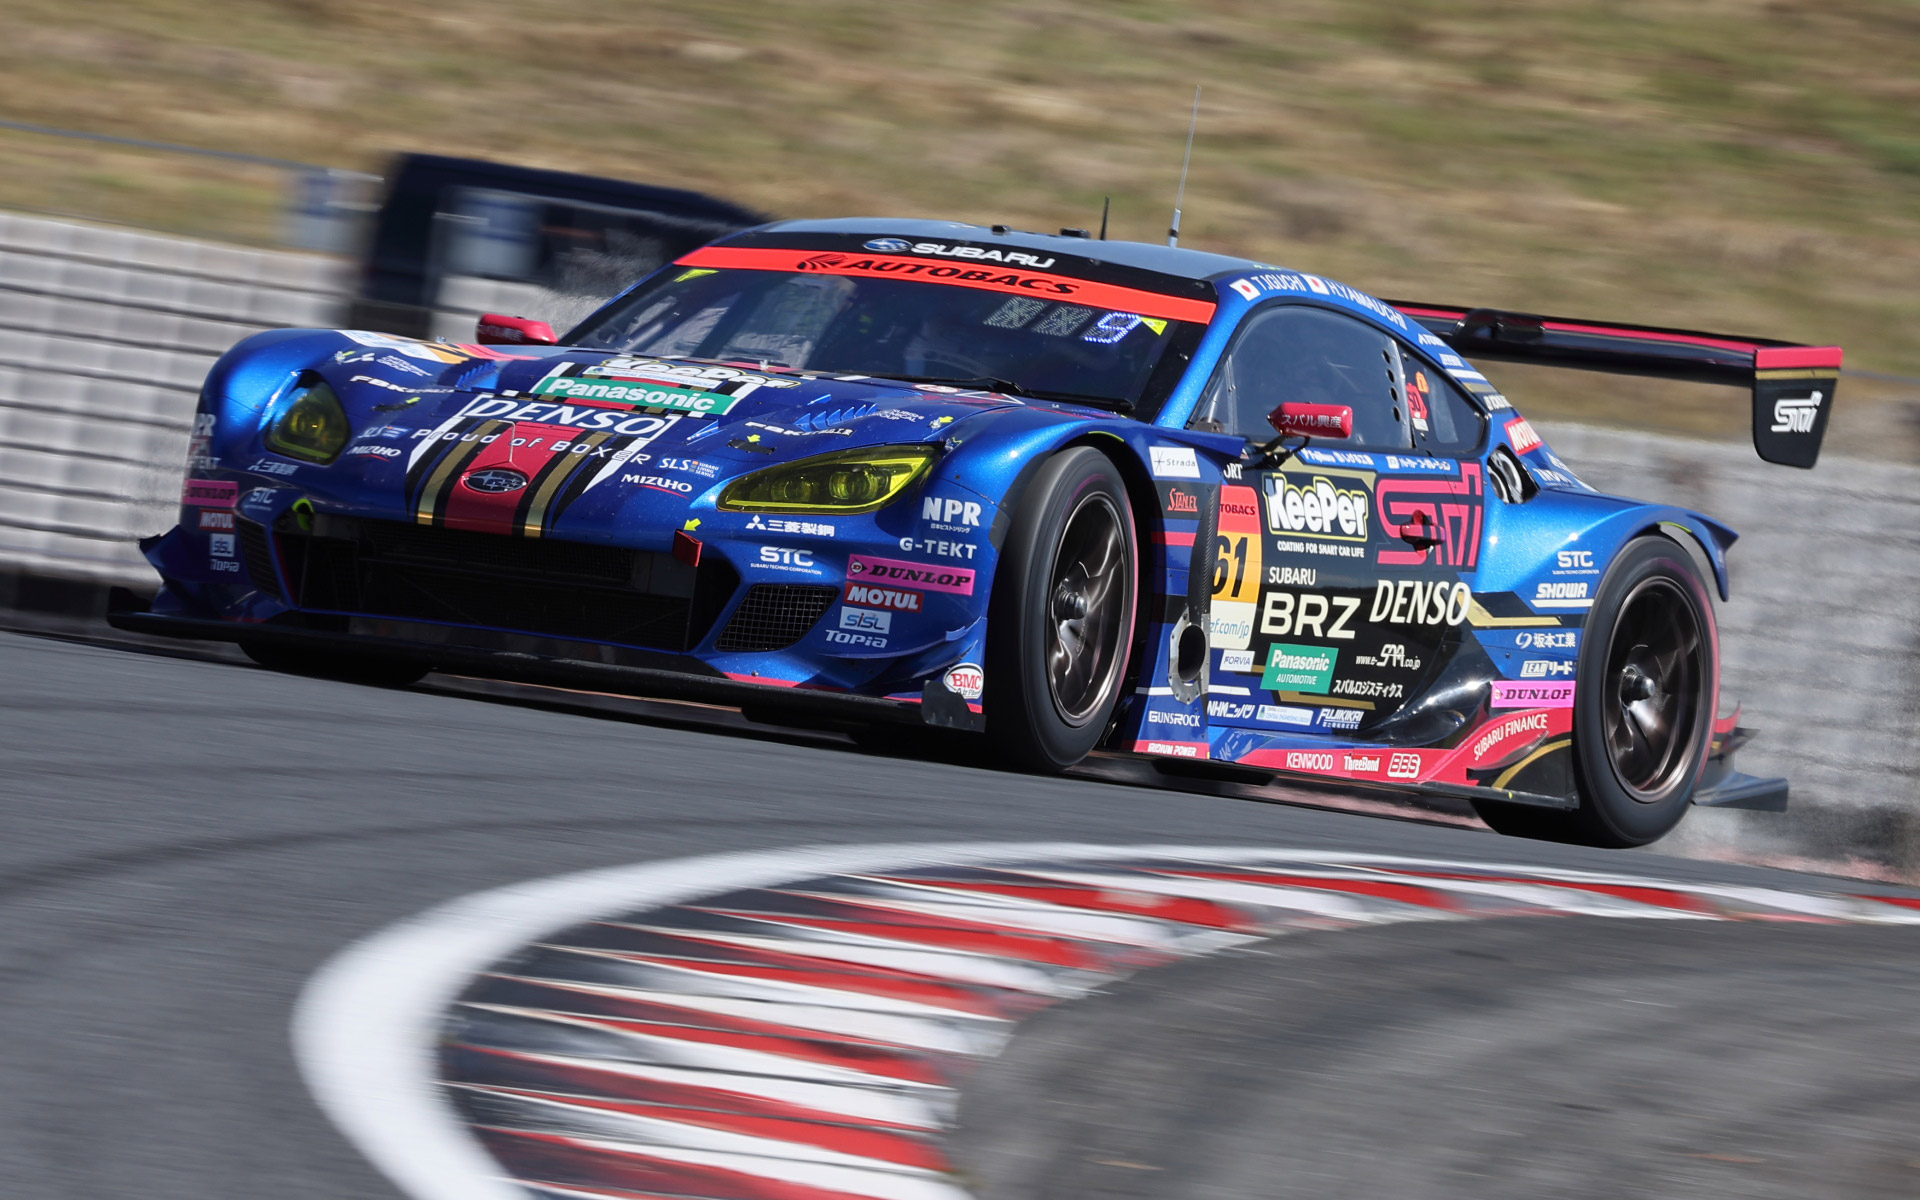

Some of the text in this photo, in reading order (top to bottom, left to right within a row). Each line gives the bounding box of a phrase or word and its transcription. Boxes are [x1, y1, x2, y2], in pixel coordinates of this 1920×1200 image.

[911, 242, 1055, 269] SUBARU
[845, 259, 1080, 295] AUTOBACS
[544, 378, 716, 412] Panasonic
[463, 400, 666, 436] DENSO
[1281, 413, 1342, 428] スバル興産
[410, 428, 501, 443] Proud
[510, 436, 543, 449] of
[347, 445, 402, 457] MIZUHO
[659, 458, 692, 471] SLS
[1166, 459, 1197, 468] Strada
[620, 474, 693, 493] MIZUHO
[250, 487, 277, 504] STC
[1167, 487, 1198, 512] STANLEY
[922, 496, 981, 527] NPR
[1265, 477, 1366, 536] KeePer
[200, 512, 234, 529] MOTUL
[767, 519, 835, 537] 三菱製鋼
[760, 546, 814, 567] STC
[899, 537, 978, 560] G-TEKT
[1305, 542, 1318, 554] FOR
[1318, 544, 1338, 556] SMART
[1338, 546, 1351, 557] CAR
[1351, 547, 1365, 558] LIFE
[1211, 535, 1248, 598] 61
[1557, 551, 1594, 568] STC
[869, 563, 971, 587] DUNLOP
[1269, 566, 1316, 586] SUBARU
[847, 586, 919, 610] MOTUL
[1535, 582, 1588, 599] SHOWA
[1369, 579, 1471, 626] DENSO
[1260, 592, 1361, 640] BRZ
[1532, 632, 1576, 649] 坂本工業
[1223, 656, 1251, 665] FORVIA
[1271, 649, 1329, 672] Panasonic
[1527, 662, 1547, 674] LEAD
[951, 673, 982, 690] BMC
[1276, 673, 1318, 685] AUTOMOTIVE
[1333, 678, 1403, 699] スバルロジスティクス
[1504, 689, 1572, 700] DUNLOP
[1148, 711, 1201, 727] GUNSROCK
[1316, 708, 1364, 725] FUJIKIKAI
[1474, 713, 1548, 761] SUBARU FINANCE
[1174, 745, 1197, 757] POWER
[1286, 752, 1334, 770] KENWOOD
[1343, 756, 1380, 772] ThreeBond
[1387, 753, 1421, 778] BBS
